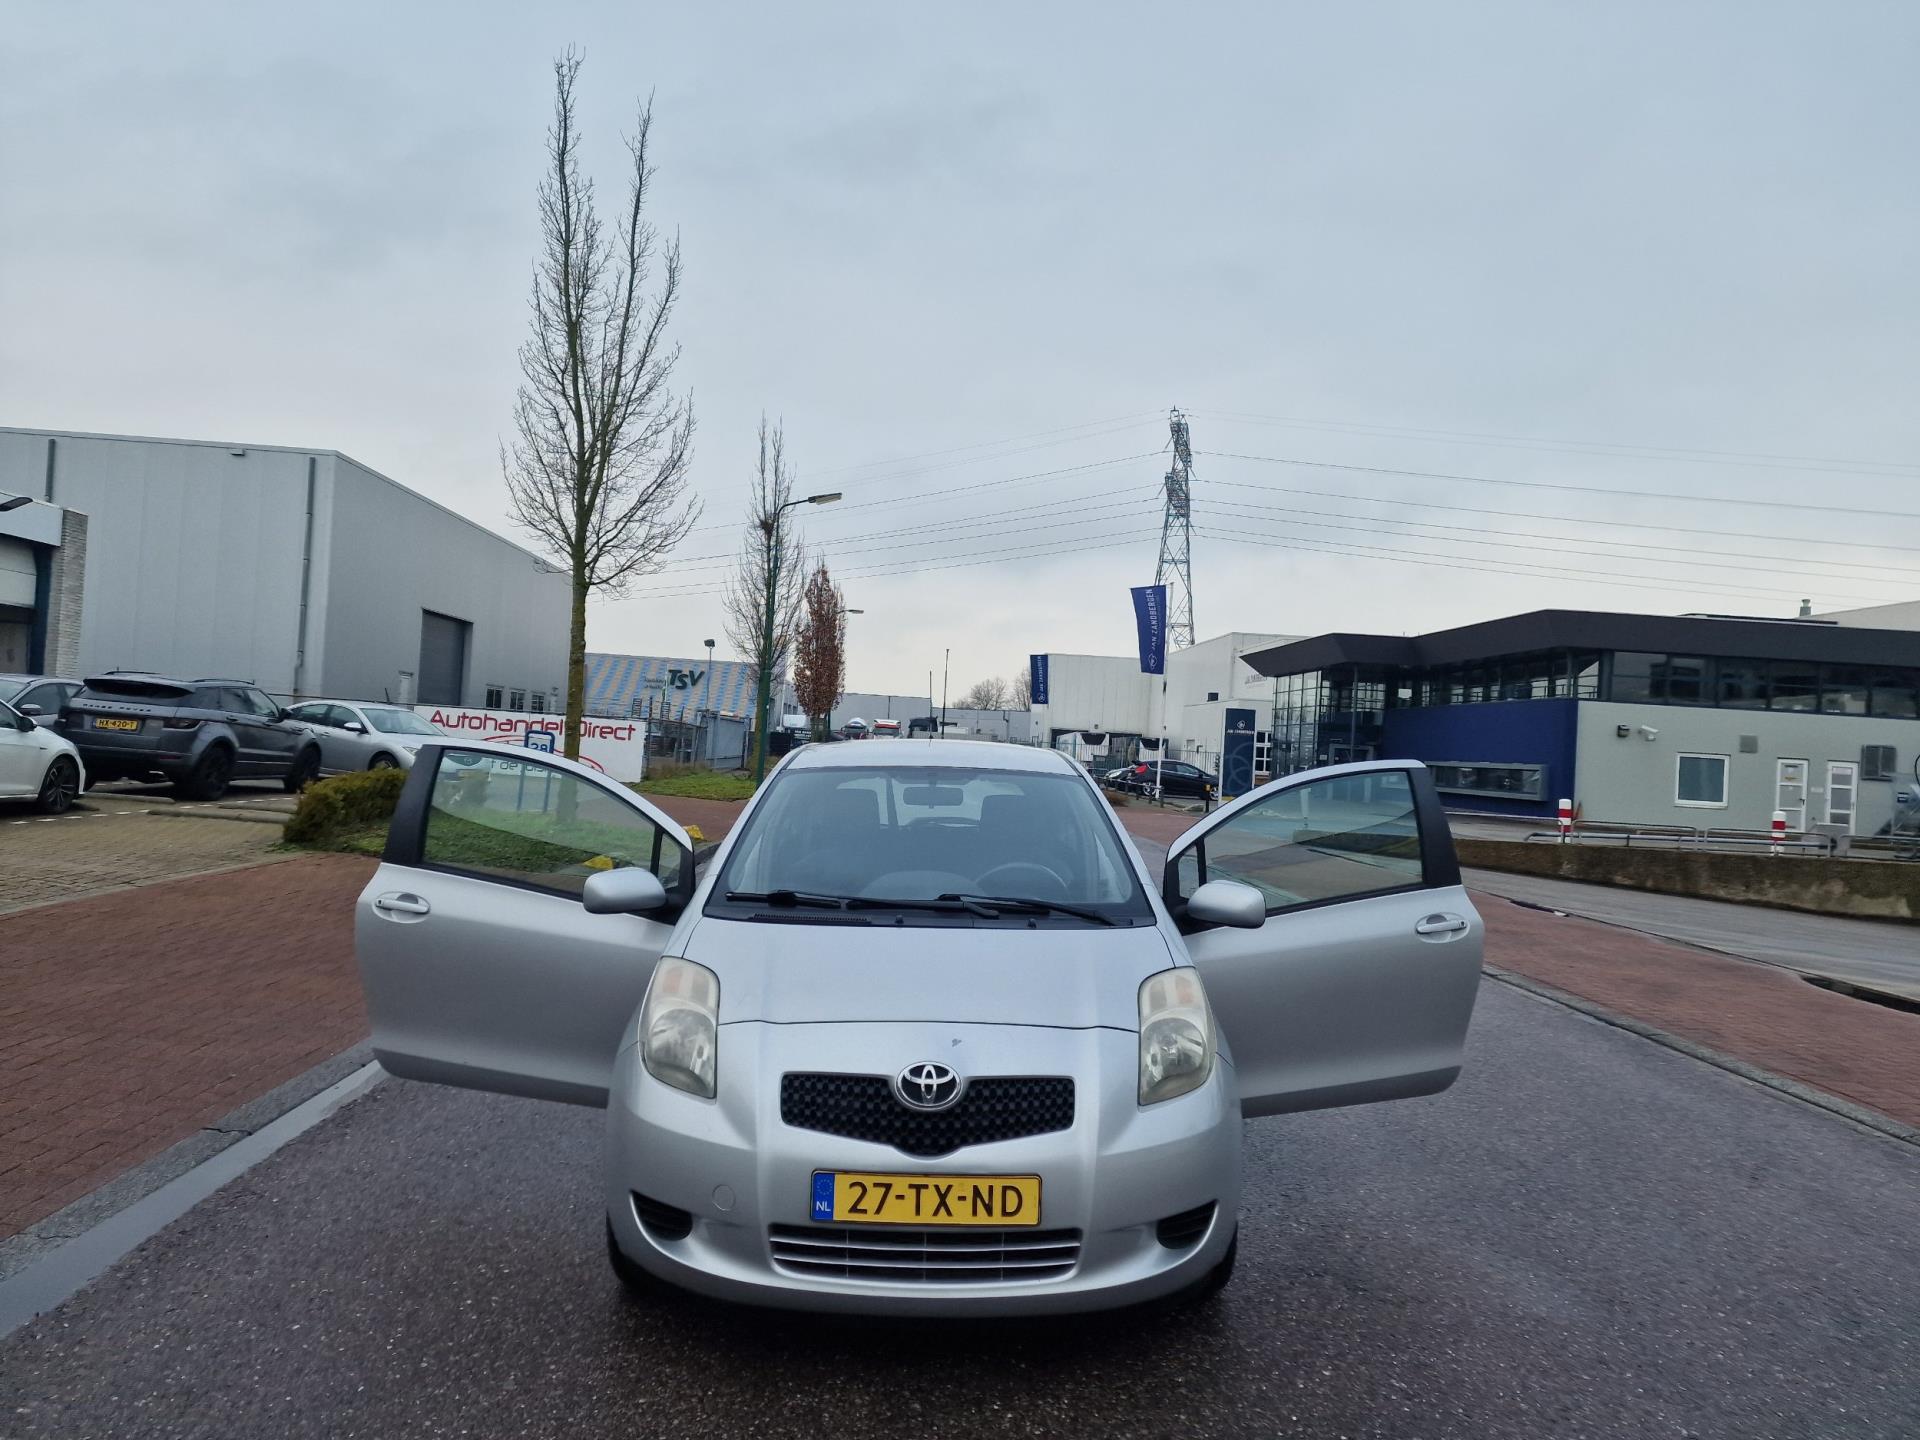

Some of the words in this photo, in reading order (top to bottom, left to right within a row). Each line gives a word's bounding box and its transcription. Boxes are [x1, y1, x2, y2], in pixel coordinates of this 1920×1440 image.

[430, 709, 564, 736] Autohandel
[816, 1201, 832, 1212] NL
[847, 1181, 1023, 1218] 27-TX-ND
